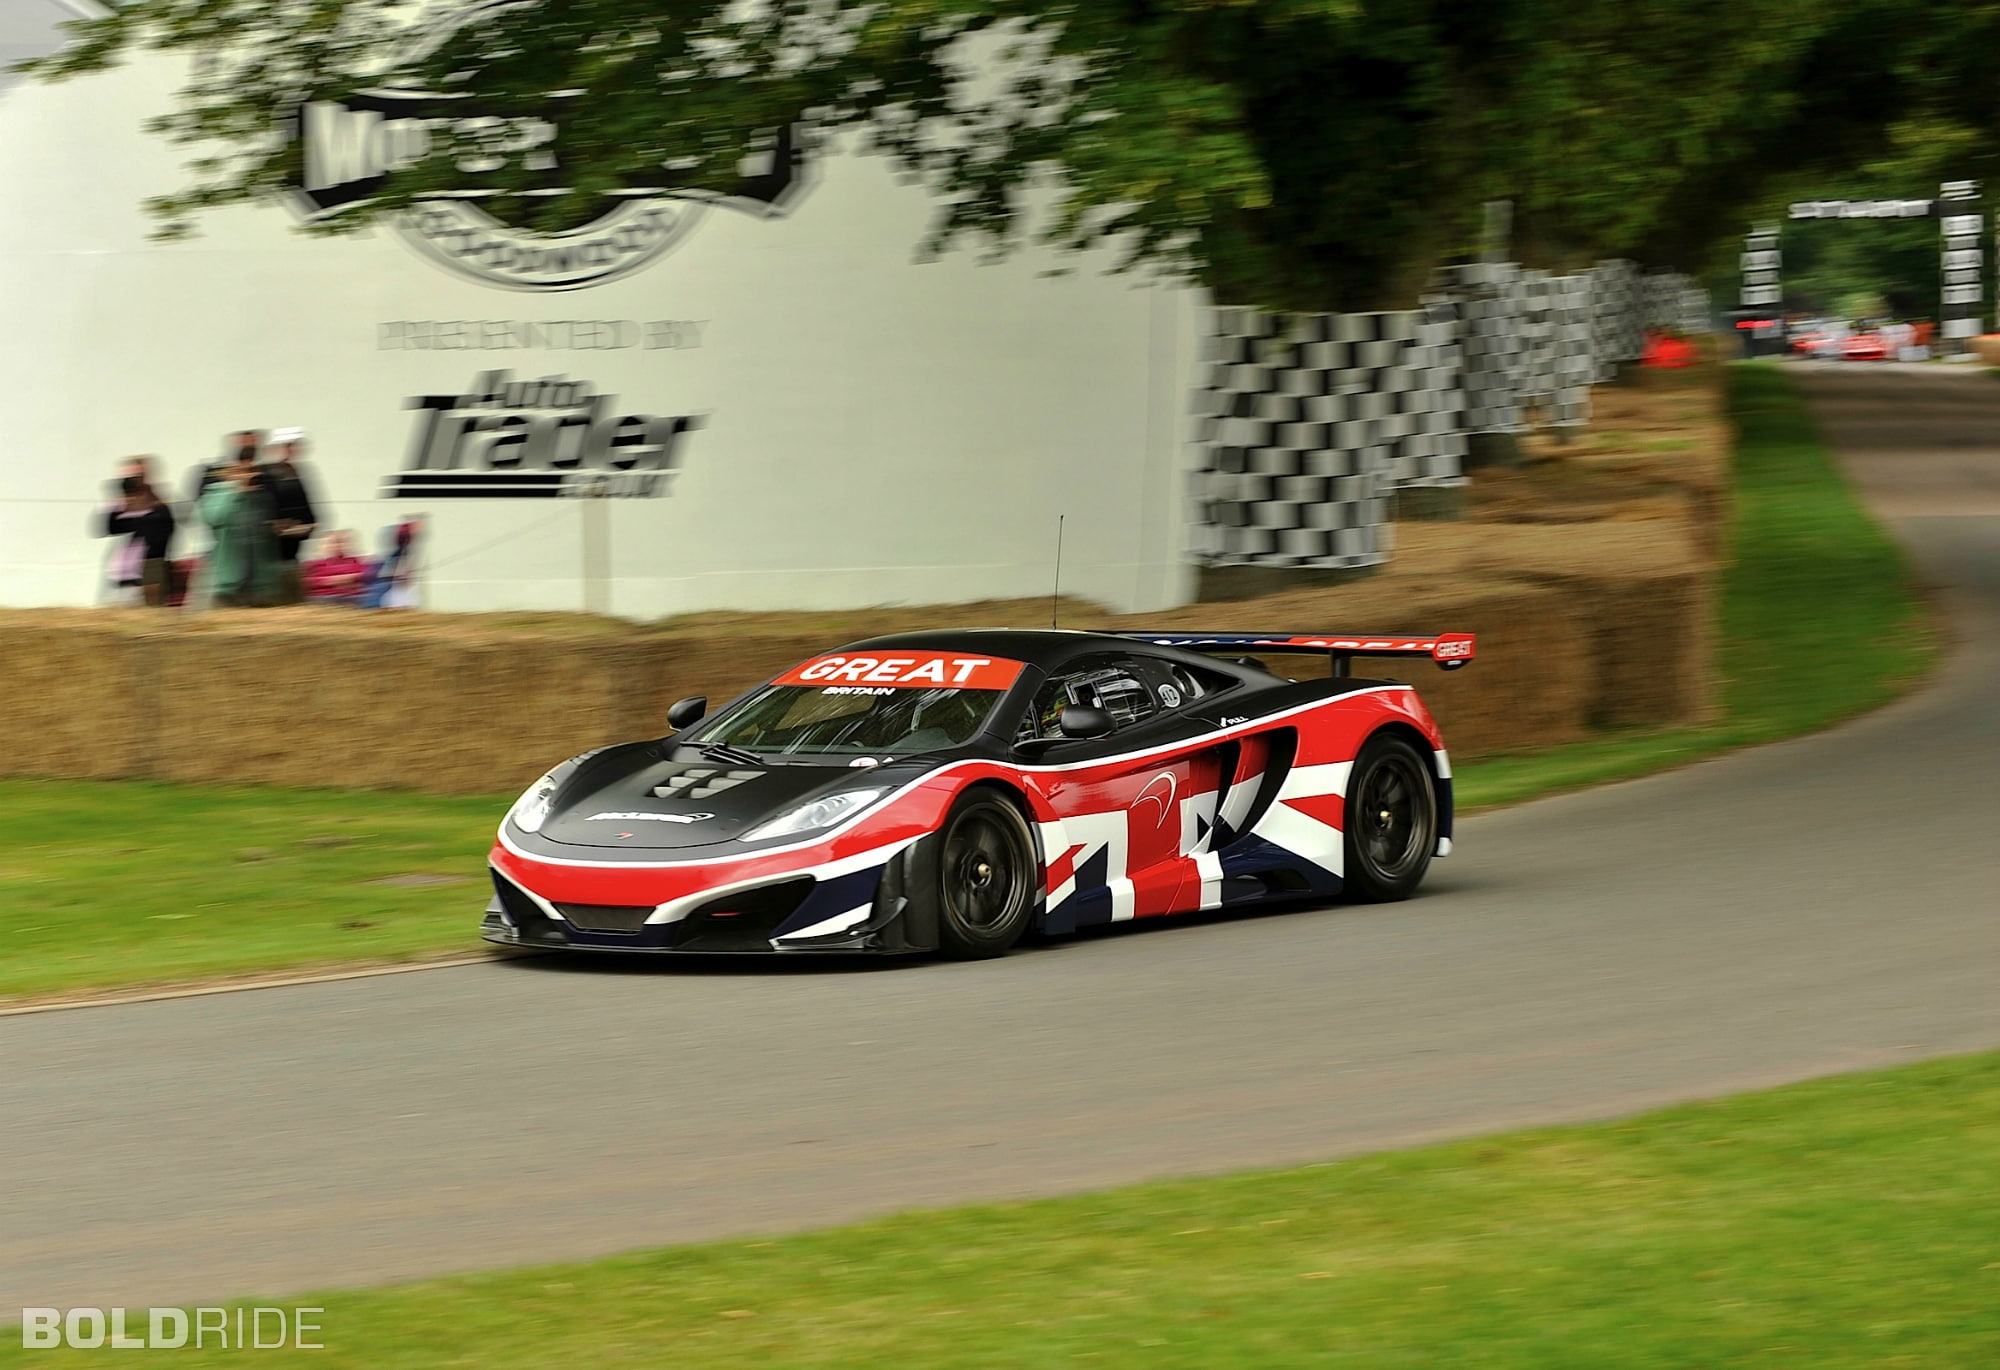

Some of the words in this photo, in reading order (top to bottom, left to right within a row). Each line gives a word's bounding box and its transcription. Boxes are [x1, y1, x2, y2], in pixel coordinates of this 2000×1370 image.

[400, 394, 712, 470] Trader
[1437, 640, 1473, 658] GREAT
[800, 657, 991, 683] GREAT
[821, 686, 897, 696] BRITAIN
